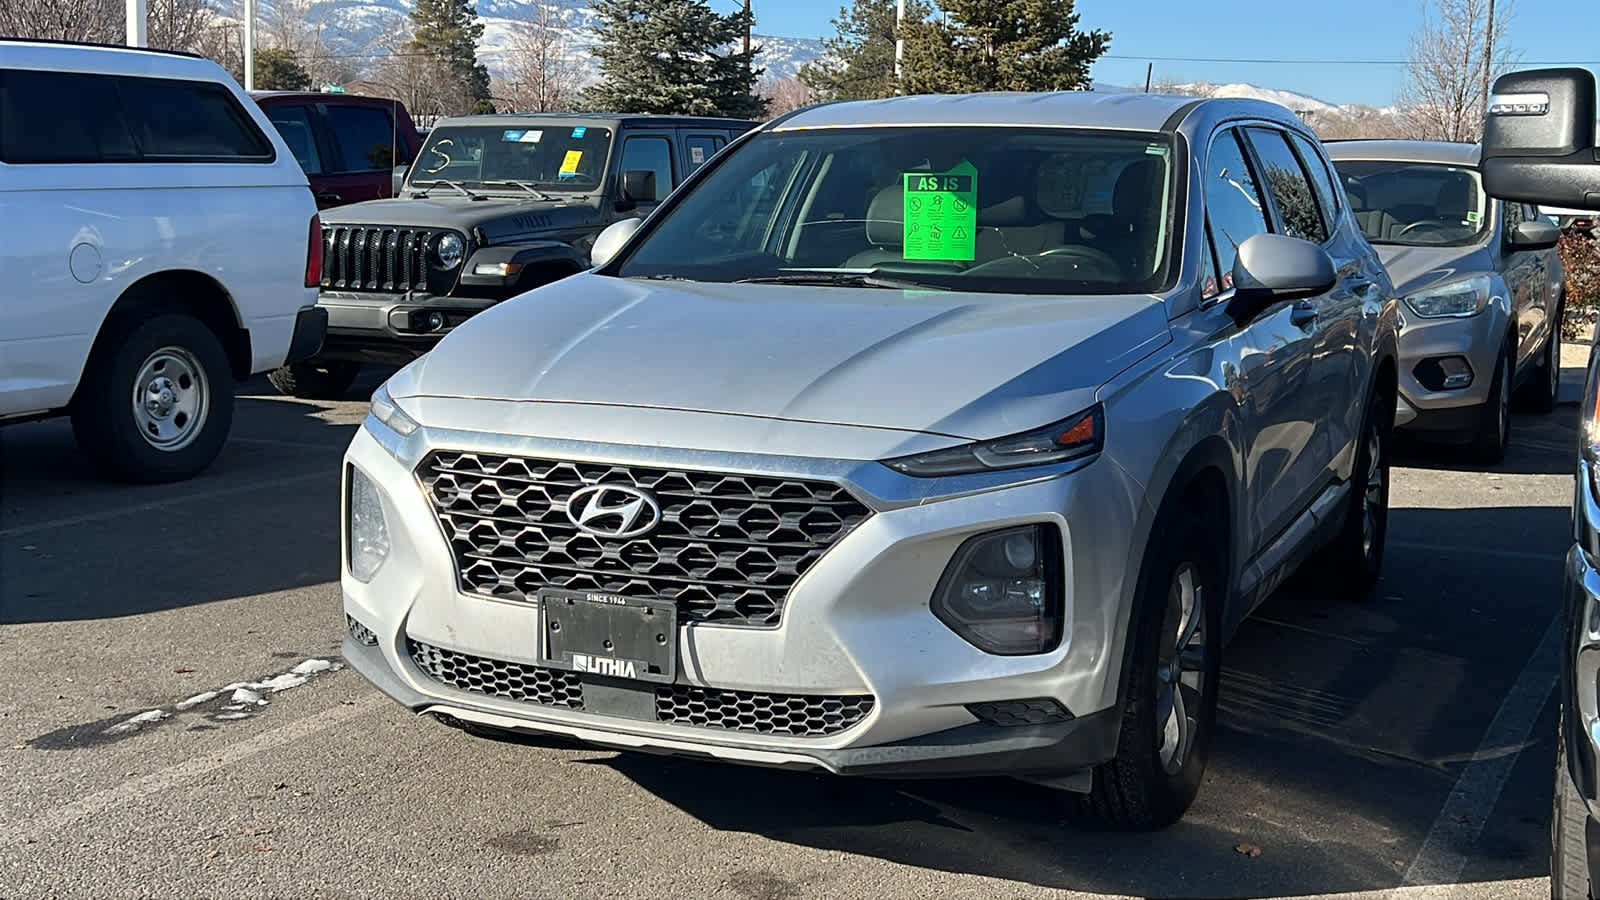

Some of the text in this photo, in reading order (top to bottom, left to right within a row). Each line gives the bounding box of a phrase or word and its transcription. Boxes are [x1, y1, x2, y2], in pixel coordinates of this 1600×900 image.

[918, 176, 959, 190] AS IS
[586, 593, 608, 603] SINCE
[587, 656, 636, 679] LITHIA
